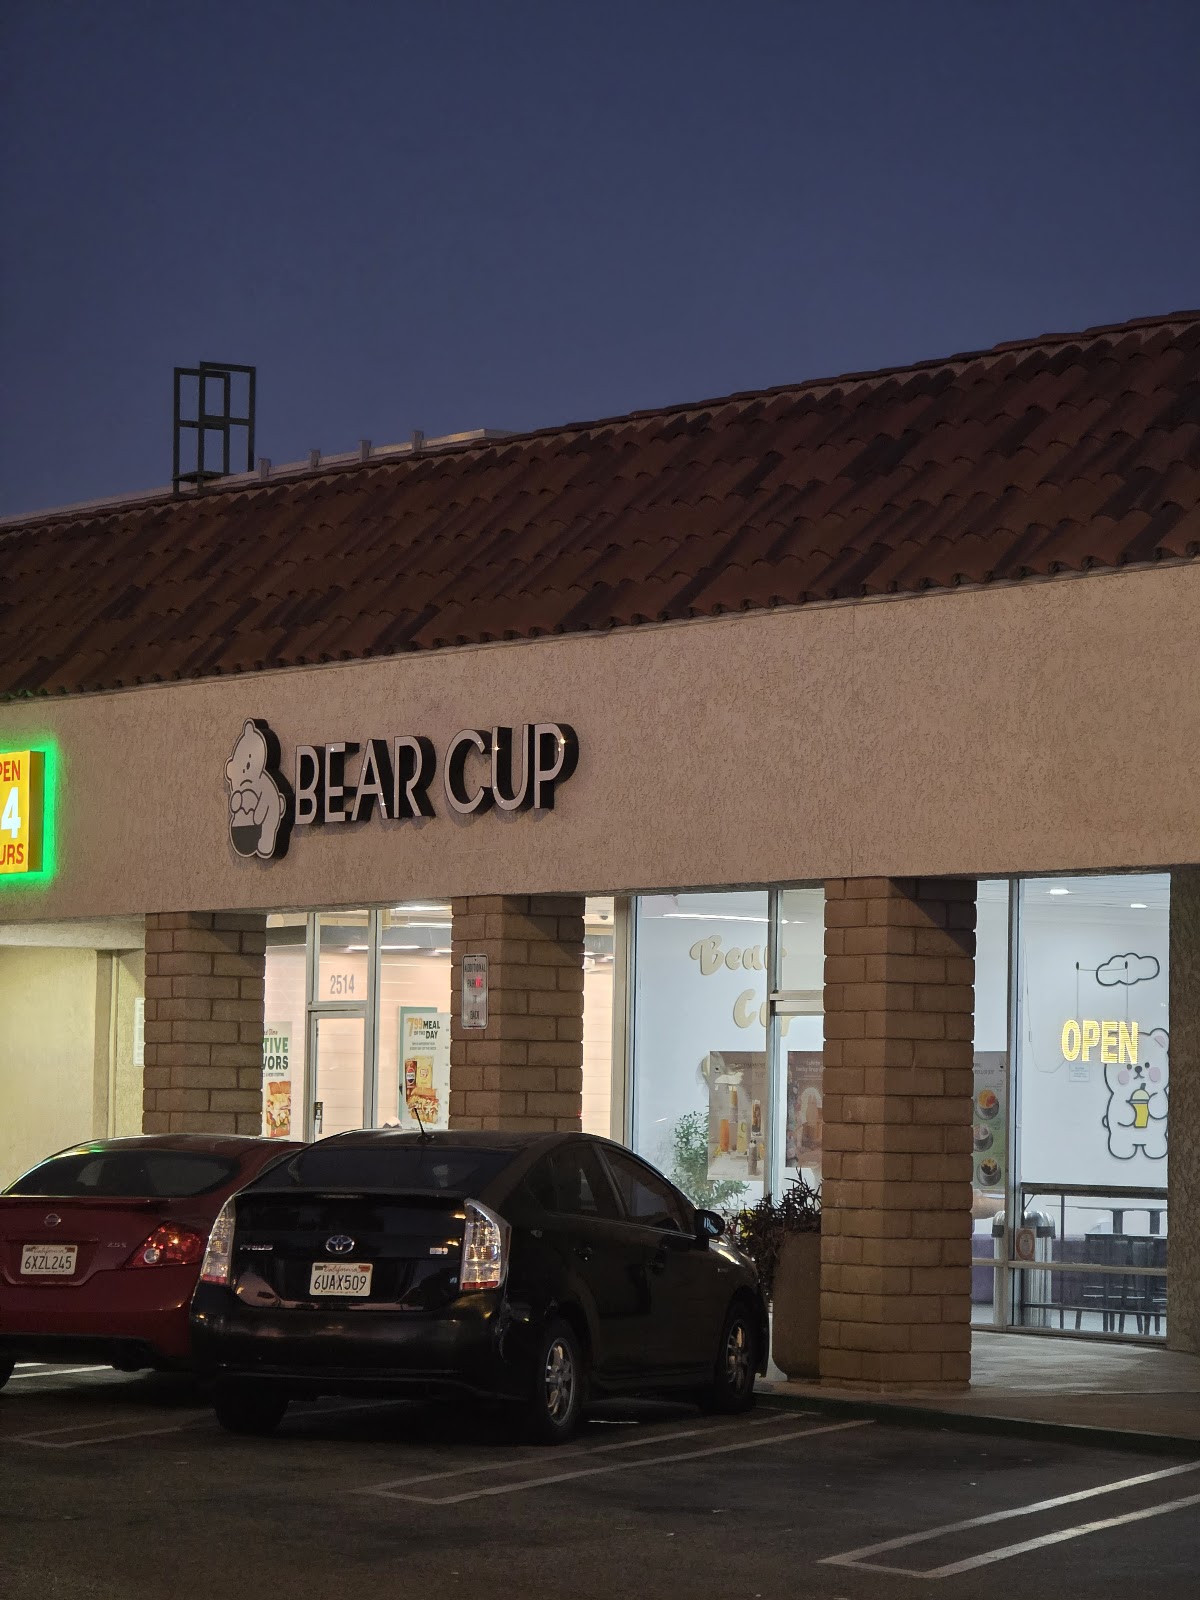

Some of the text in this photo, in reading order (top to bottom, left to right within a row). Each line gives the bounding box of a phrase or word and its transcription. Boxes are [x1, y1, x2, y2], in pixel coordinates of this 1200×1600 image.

[295, 721, 579, 826] BEAR CUP
[464, 963, 486, 973] ADDITIONAL
[330, 974, 355, 995] 2514
[422, 1020, 441, 1030] MEAL
[425, 1030, 438, 1040] DAY
[1061, 1019, 1140, 1065] OPEN
[24, 1255, 72, 1270] 6XZL245
[323, 1264, 359, 1274] California
[314, 1274, 367, 1291] 6UAX509
